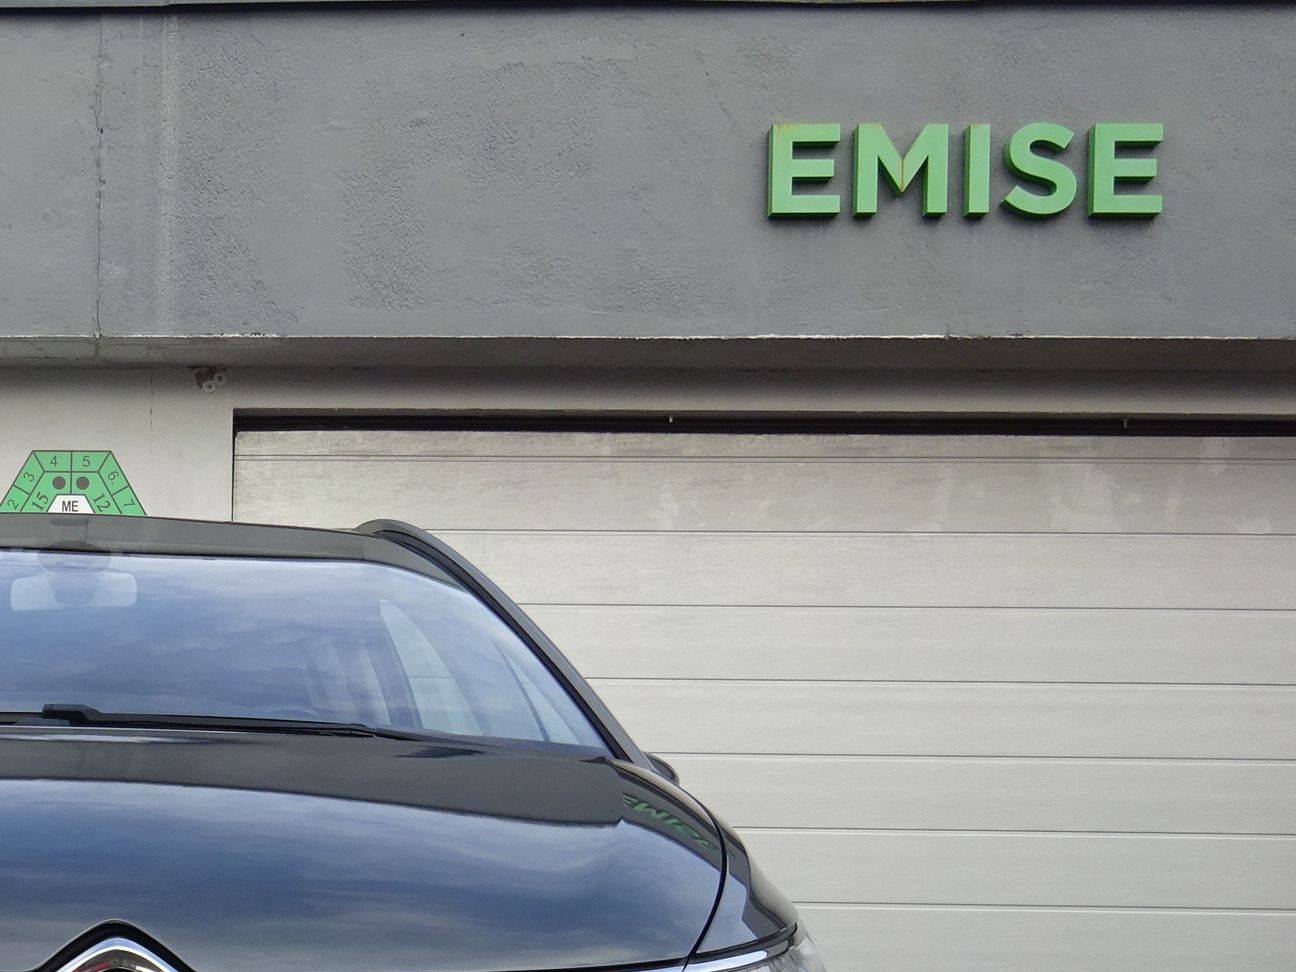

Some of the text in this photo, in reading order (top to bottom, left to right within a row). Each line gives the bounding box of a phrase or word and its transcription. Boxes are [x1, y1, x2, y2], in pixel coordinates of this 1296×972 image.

[767, 122, 1165, 218] EMISE
[49, 455, 58, 467] 4
[82, 455, 91, 468] 5
[23, 471, 35, 482] 3
[7, 498, 19, 510] 2
[61, 500, 79, 512] ME
[122, 498, 136, 508] 7
